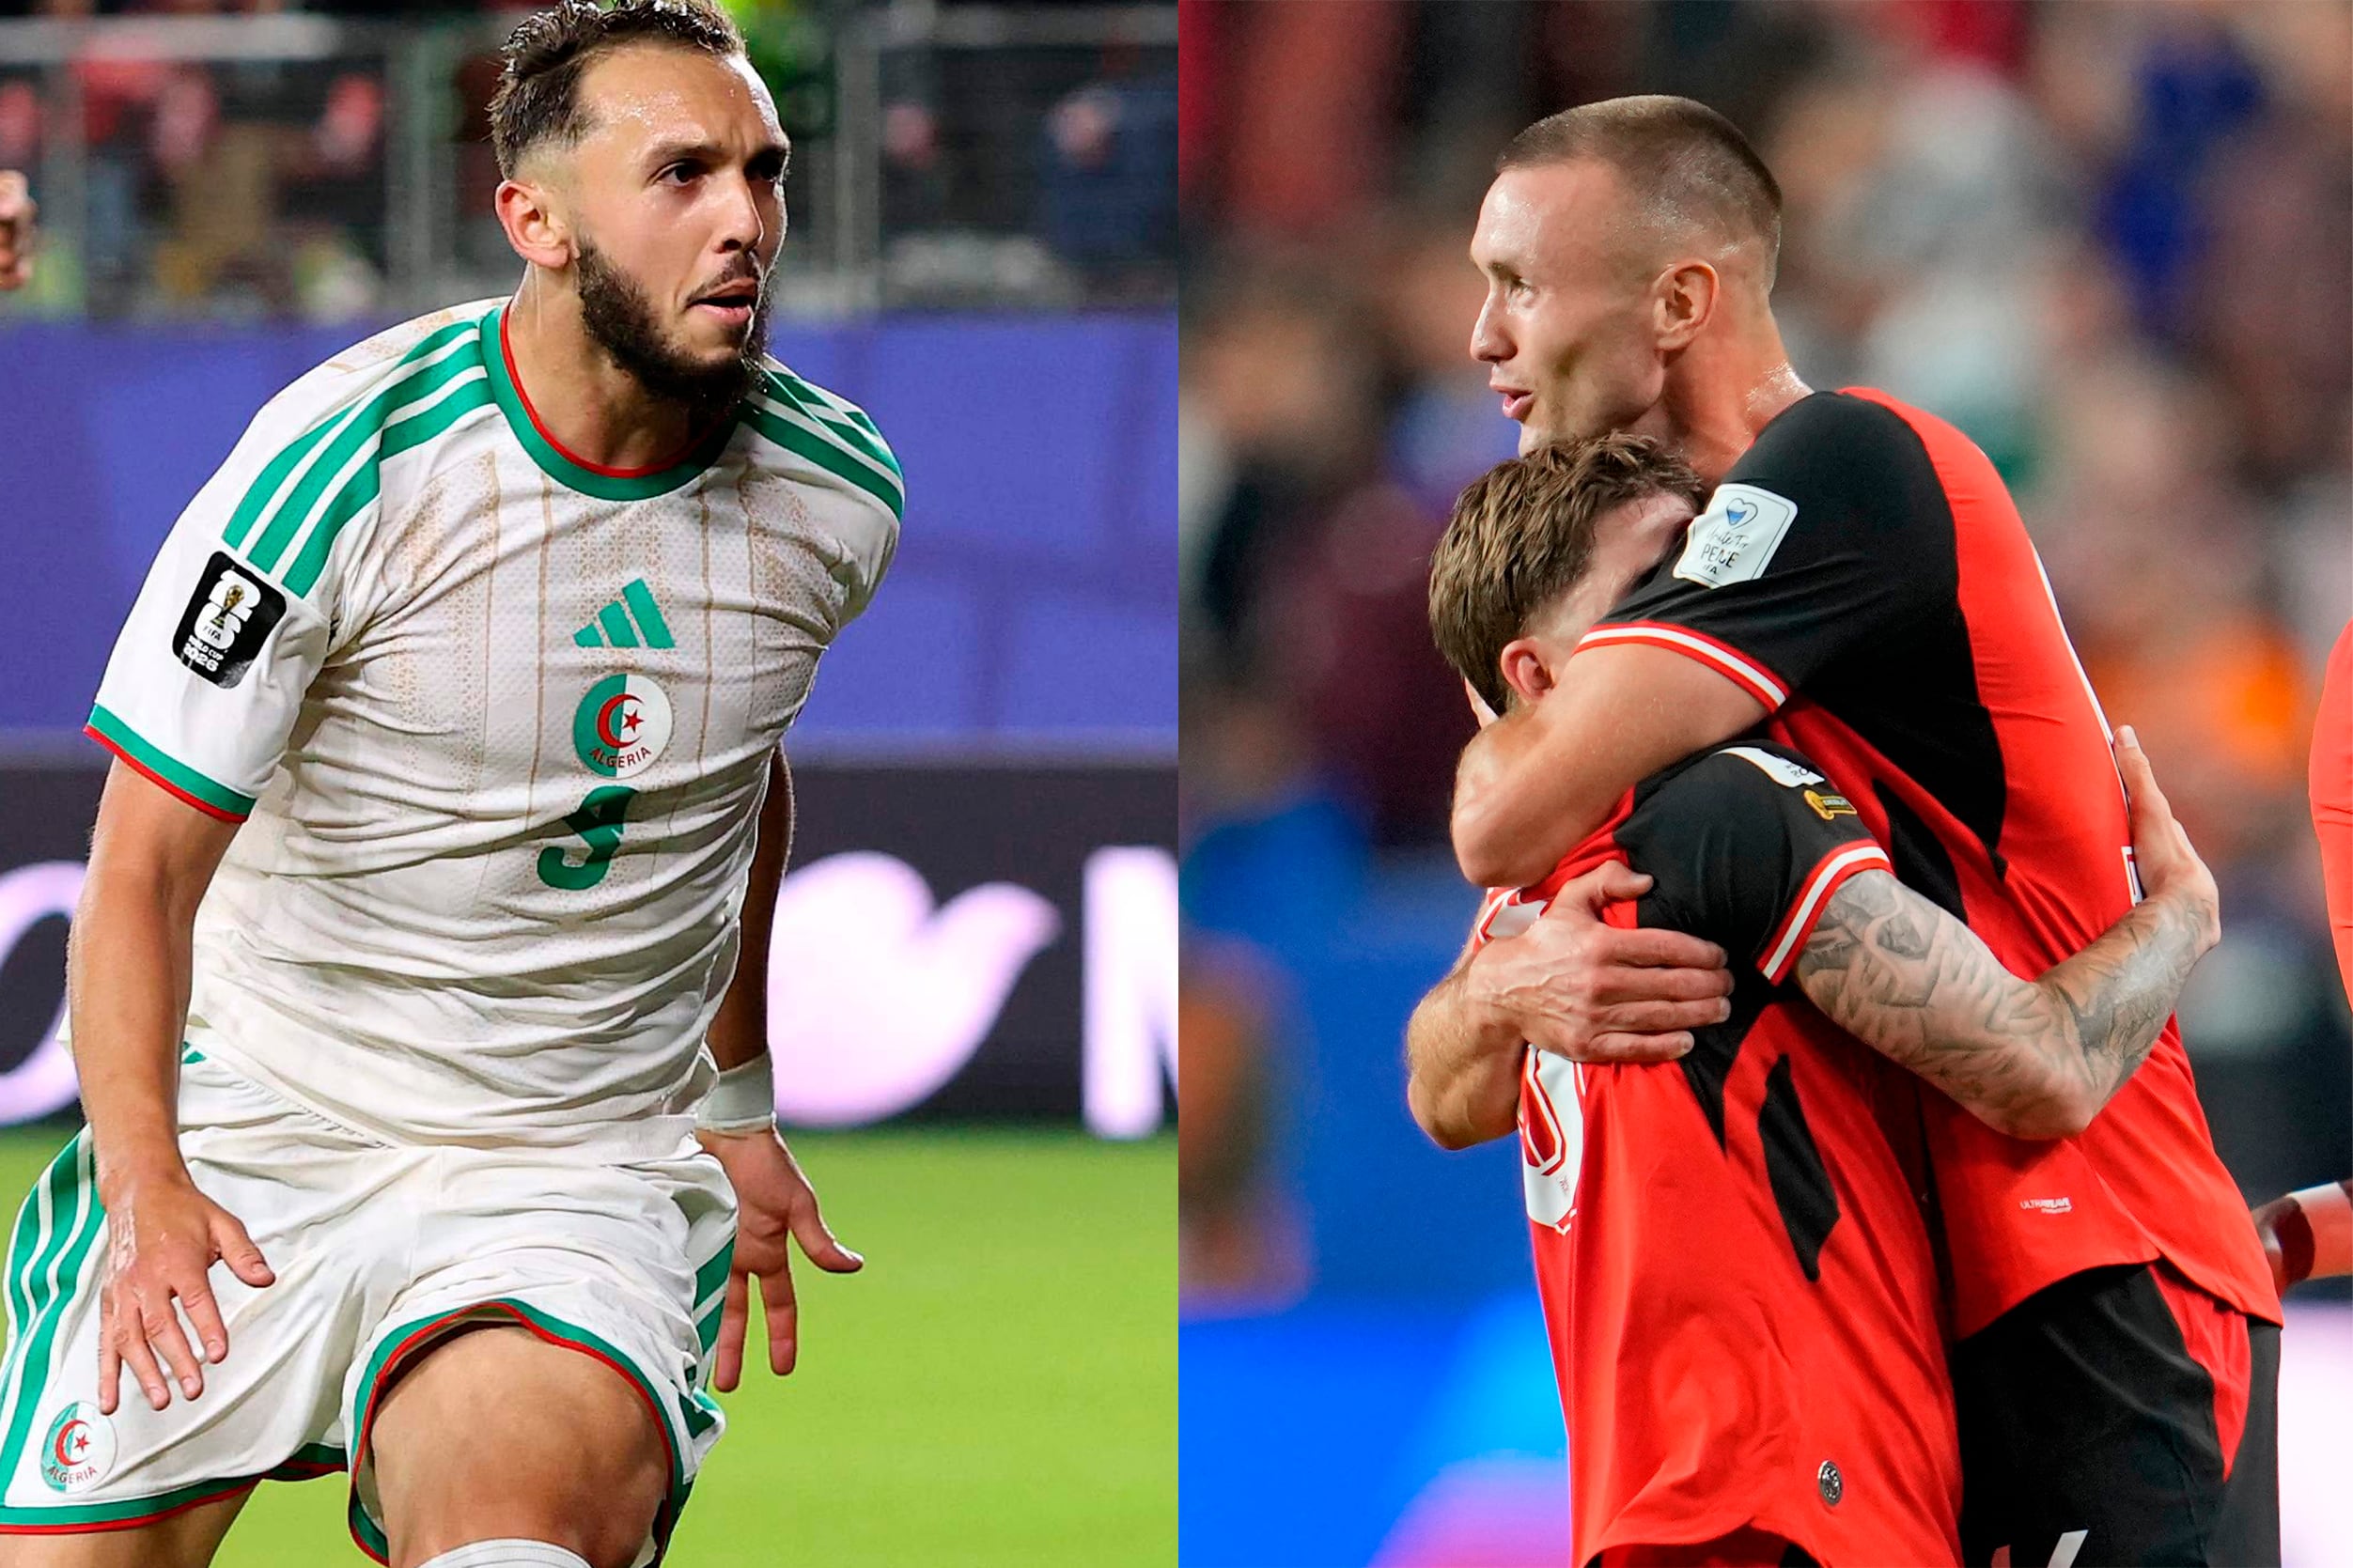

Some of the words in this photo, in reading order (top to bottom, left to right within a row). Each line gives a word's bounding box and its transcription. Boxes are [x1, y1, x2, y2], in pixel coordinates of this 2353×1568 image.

[182, 642, 220, 673] 2026
[588, 746, 652, 768] ALGERIA
[47, 1466, 98, 1484] ALGERIA
